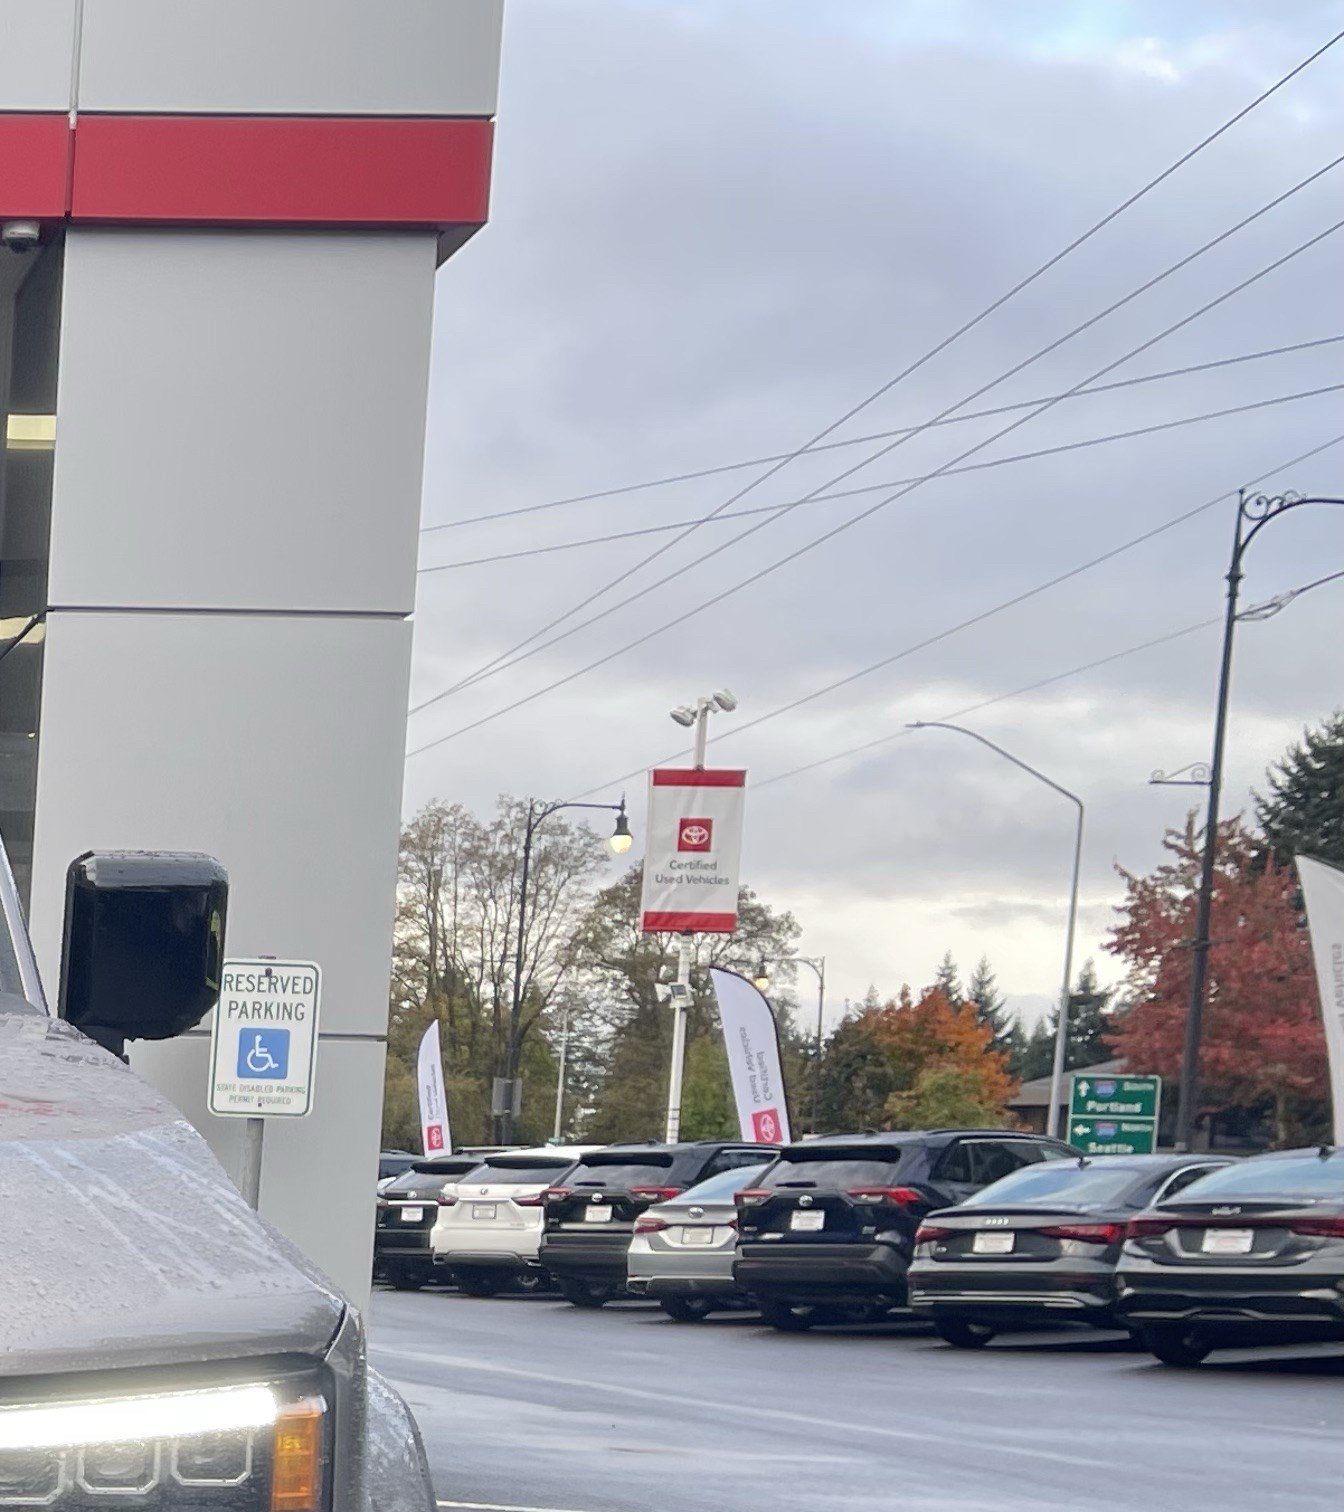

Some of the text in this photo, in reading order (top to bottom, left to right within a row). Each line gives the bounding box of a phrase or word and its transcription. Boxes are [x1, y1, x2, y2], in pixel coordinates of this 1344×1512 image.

[669, 860, 718, 870] Certified
[655, 874, 730, 885] Used Vehicles
[223, 973, 313, 995] RESERVED
[228, 1000, 305, 1021] PARKING
